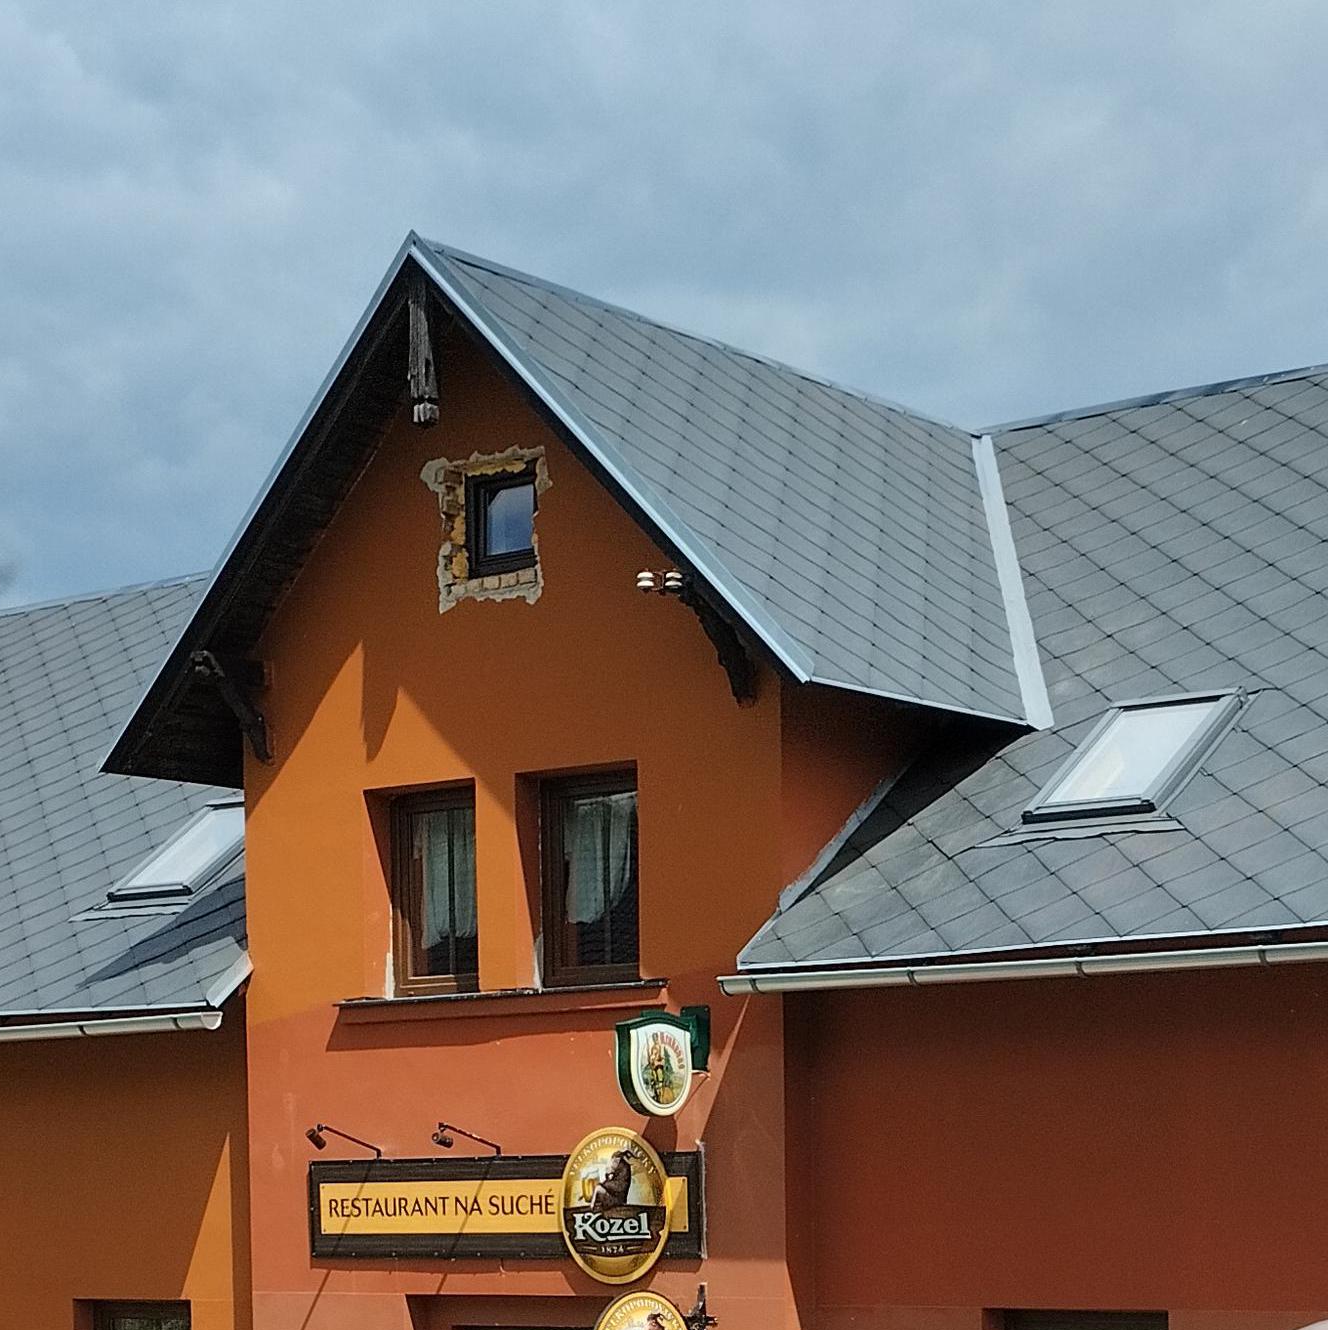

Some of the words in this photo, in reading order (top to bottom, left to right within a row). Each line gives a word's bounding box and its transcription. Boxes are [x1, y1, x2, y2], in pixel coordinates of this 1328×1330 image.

[329, 1196, 449, 1218] RESTAURANT
[454, 1195, 483, 1217] NA
[488, 1188, 556, 1216] SUCHÉ
[573, 1212, 651, 1242] Kozel
